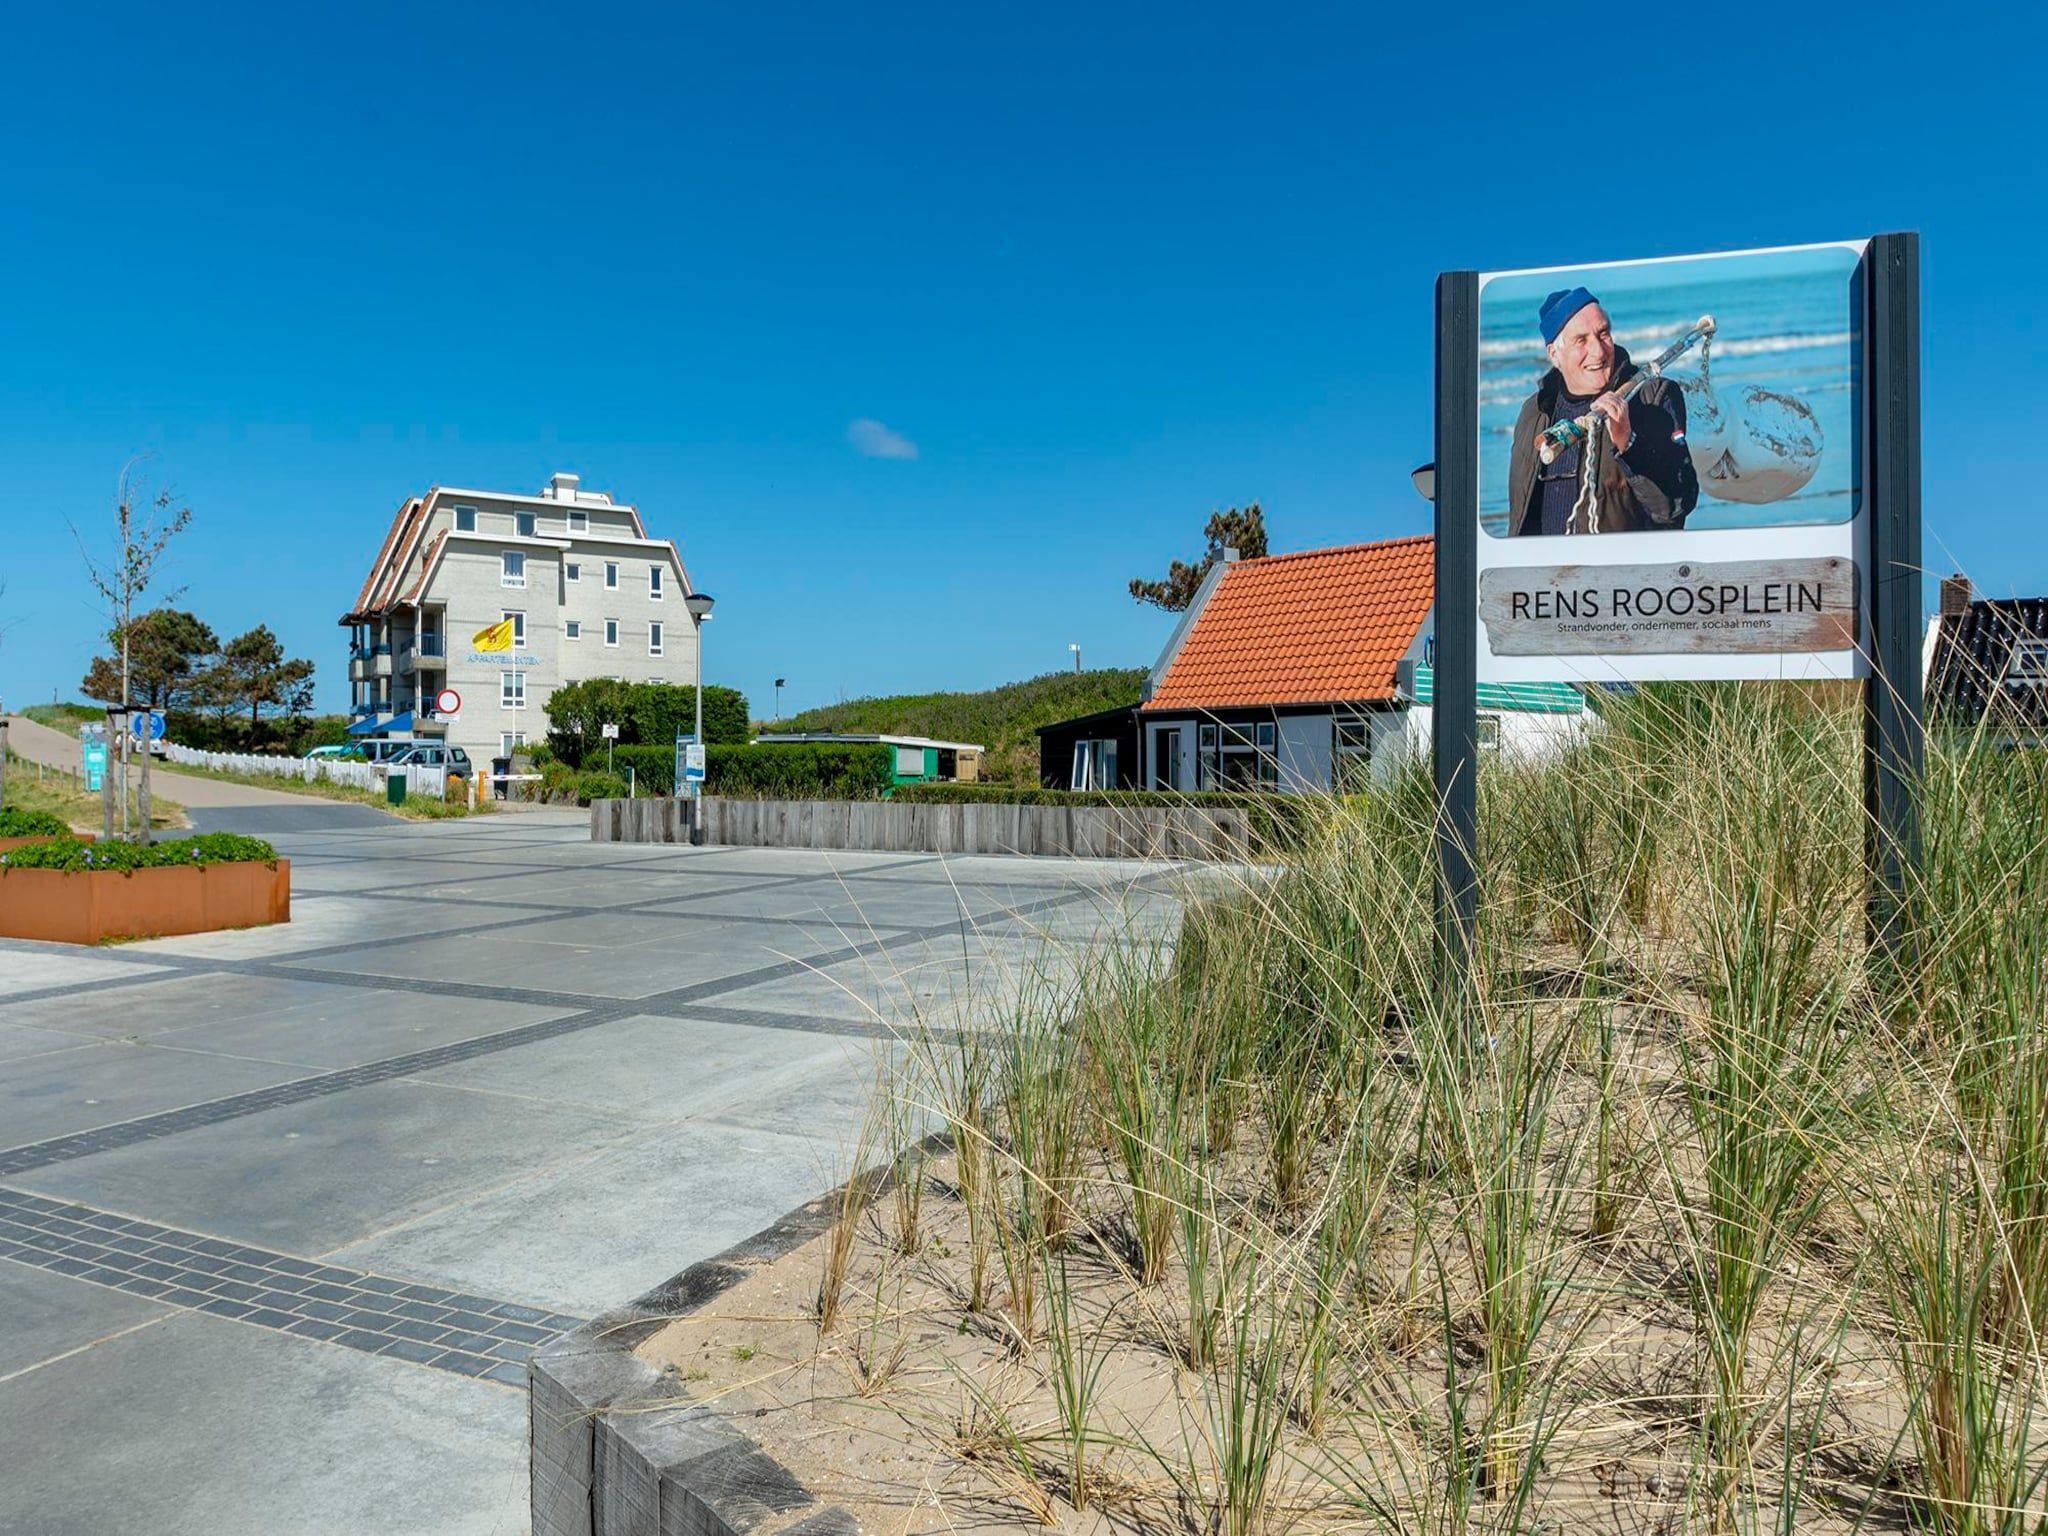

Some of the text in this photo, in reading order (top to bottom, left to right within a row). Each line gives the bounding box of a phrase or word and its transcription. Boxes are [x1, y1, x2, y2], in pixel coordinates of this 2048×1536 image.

[1512, 583, 1822, 619] RENS ROOSPLEIN
[1557, 618, 1772, 633] Strandvonder, ondernemer, sociaal mens
